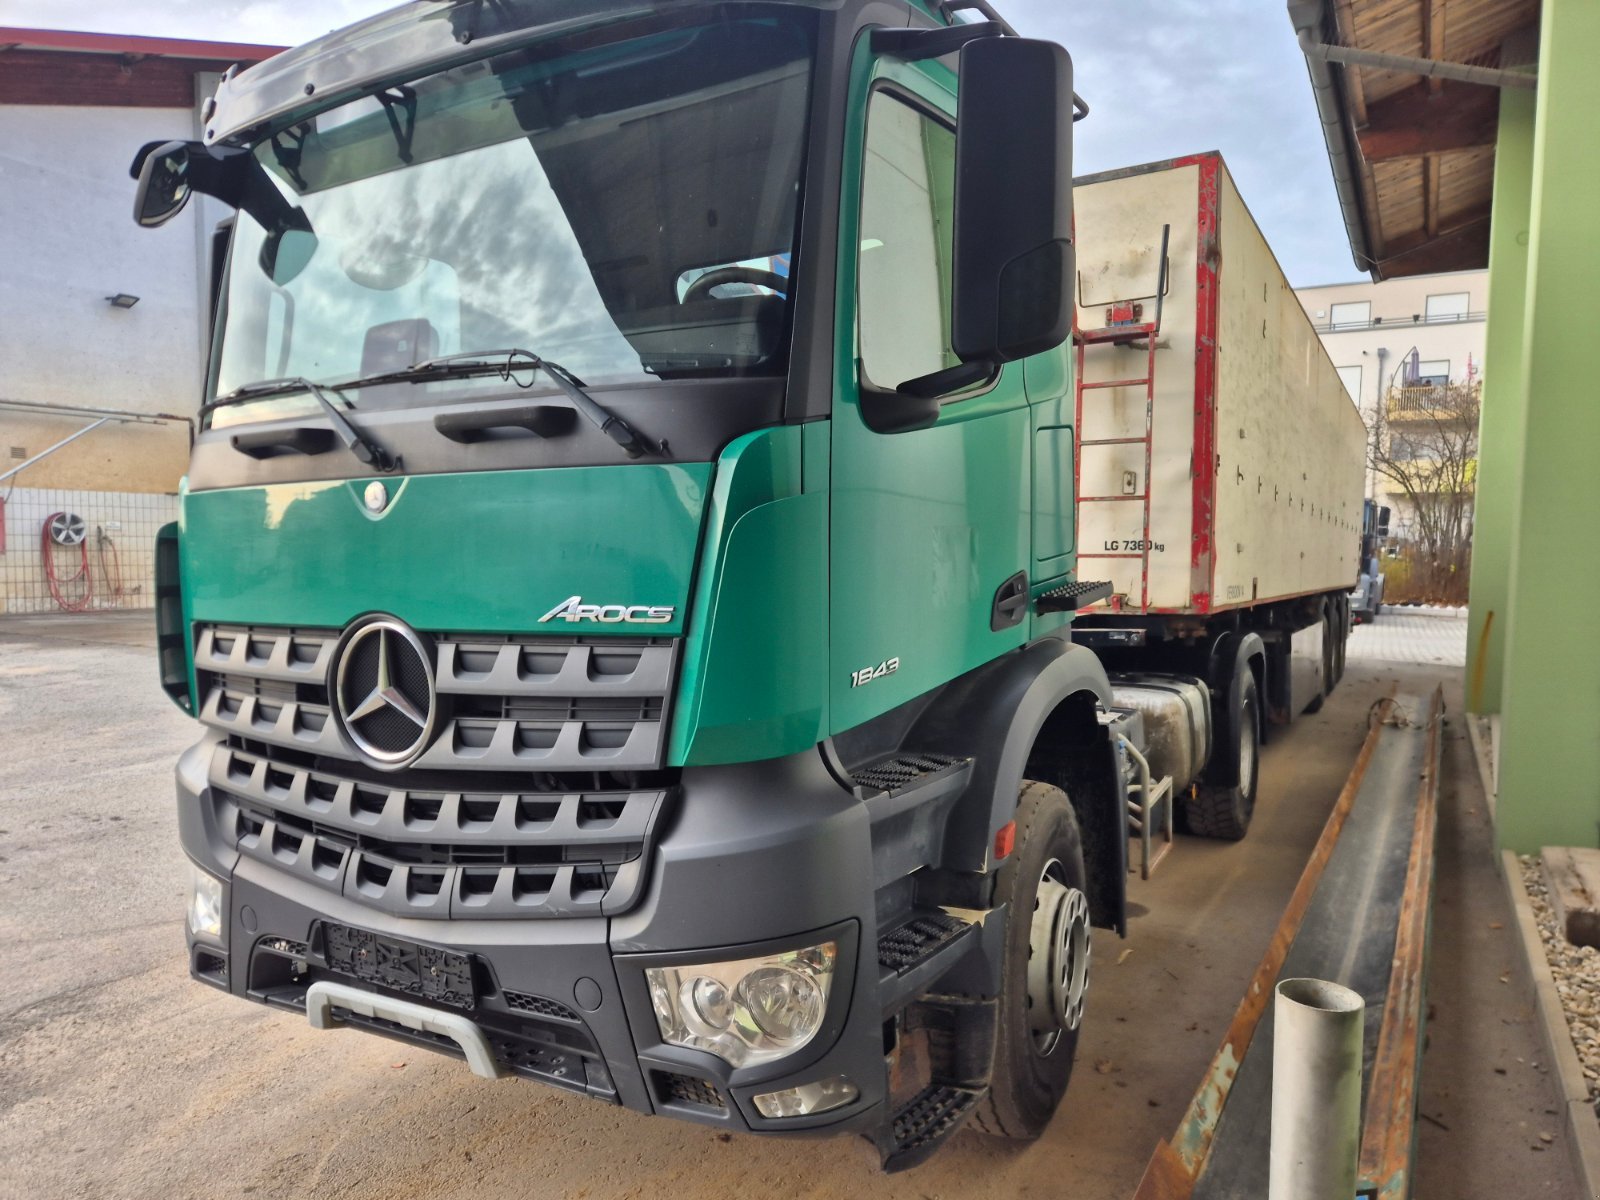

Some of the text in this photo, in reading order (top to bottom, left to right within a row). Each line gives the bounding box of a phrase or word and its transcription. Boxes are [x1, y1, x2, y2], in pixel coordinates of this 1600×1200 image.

[1104, 540, 1119, 551] LG
[1154, 542, 1165, 552] kg
[537, 595, 674, 623] AROCS
[850, 656, 899, 688] 1843
